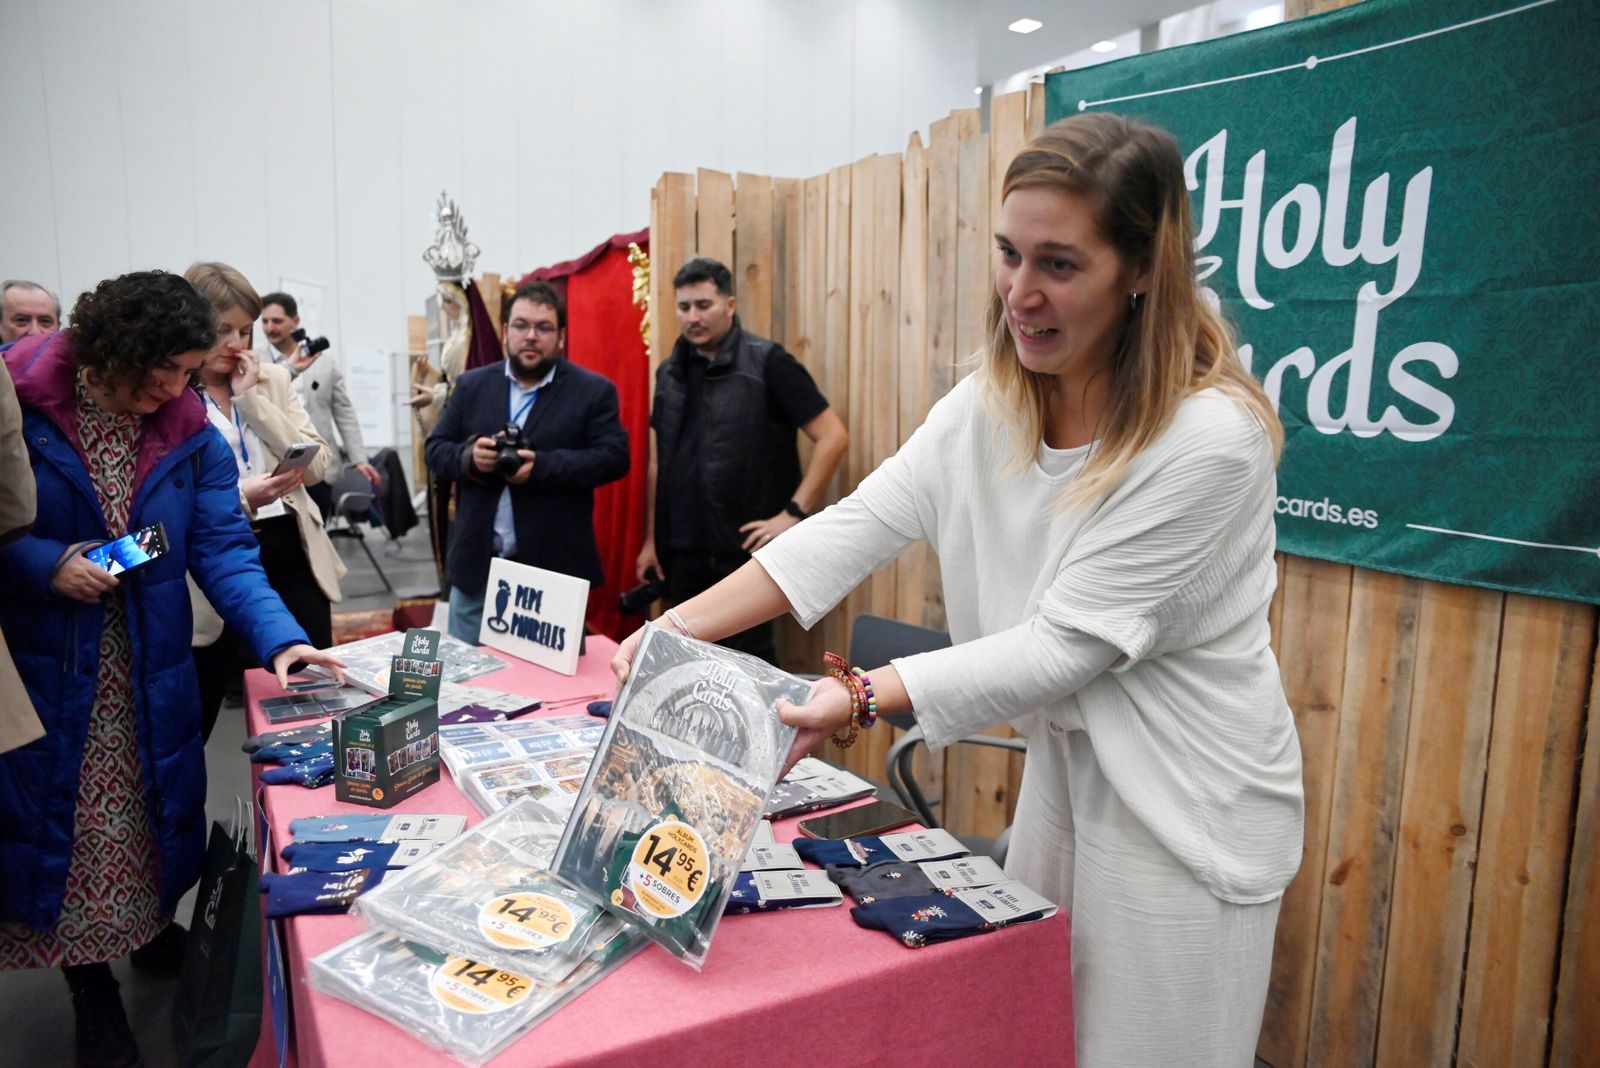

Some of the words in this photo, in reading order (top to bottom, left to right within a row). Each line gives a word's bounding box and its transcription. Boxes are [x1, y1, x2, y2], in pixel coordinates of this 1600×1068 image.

[1184, 116, 1433, 310] Holy
[1197, 256, 1459, 442] rds
[692, 680, 732, 711] Cards
[652, 879, 681, 904] SOBRES
